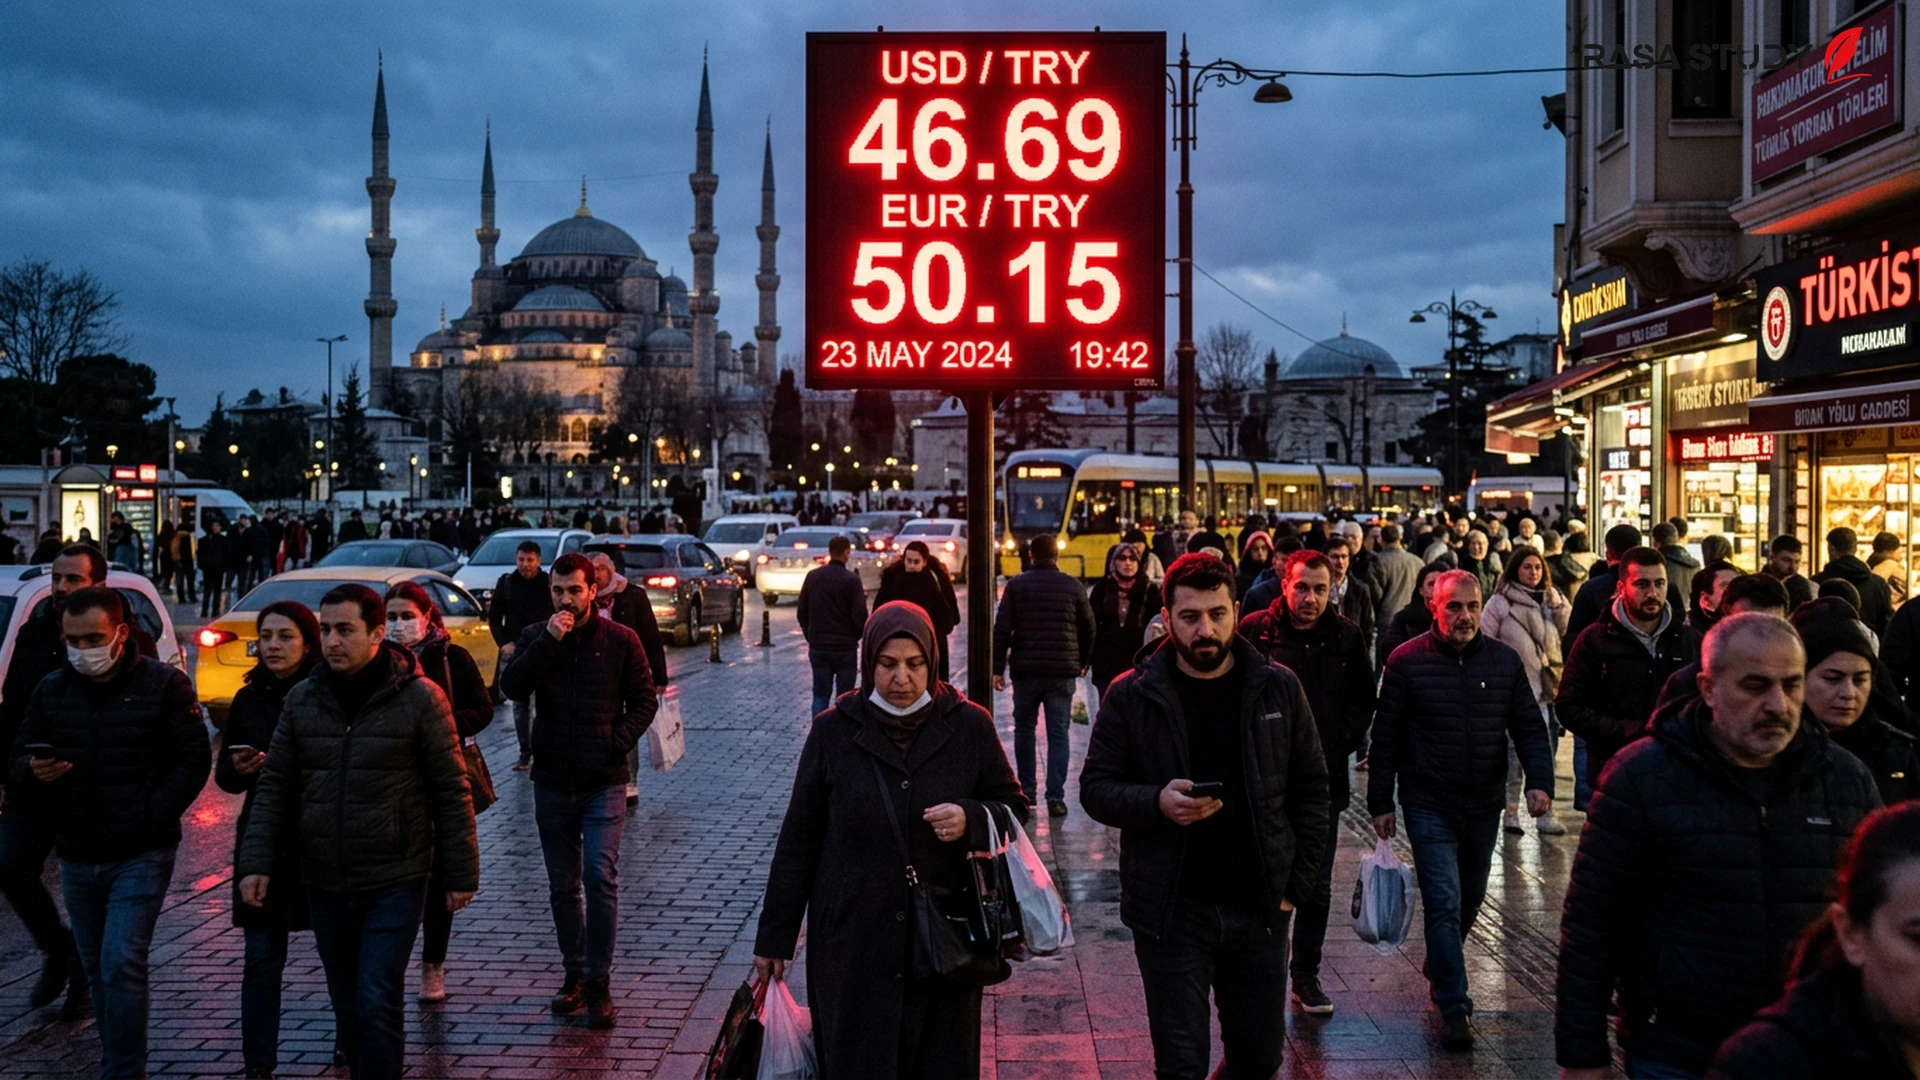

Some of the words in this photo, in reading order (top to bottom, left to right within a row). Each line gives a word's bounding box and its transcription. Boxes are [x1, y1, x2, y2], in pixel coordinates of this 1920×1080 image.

[882, 50, 967, 84] USD
[979, 50, 993, 84] /
[1004, 50, 1090, 84] TRY
[848, 98, 1122, 181] 46.69
[882, 194, 968, 228] EUR
[979, 194, 993, 228] /
[1004, 194, 1089, 228] TRY
[850, 241, 1121, 324] 50.15
[821, 341, 857, 368] 23
[867, 341, 933, 368] MAY
[941, 341, 1013, 369] 2024
[1069, 341, 1149, 369] 19:42
